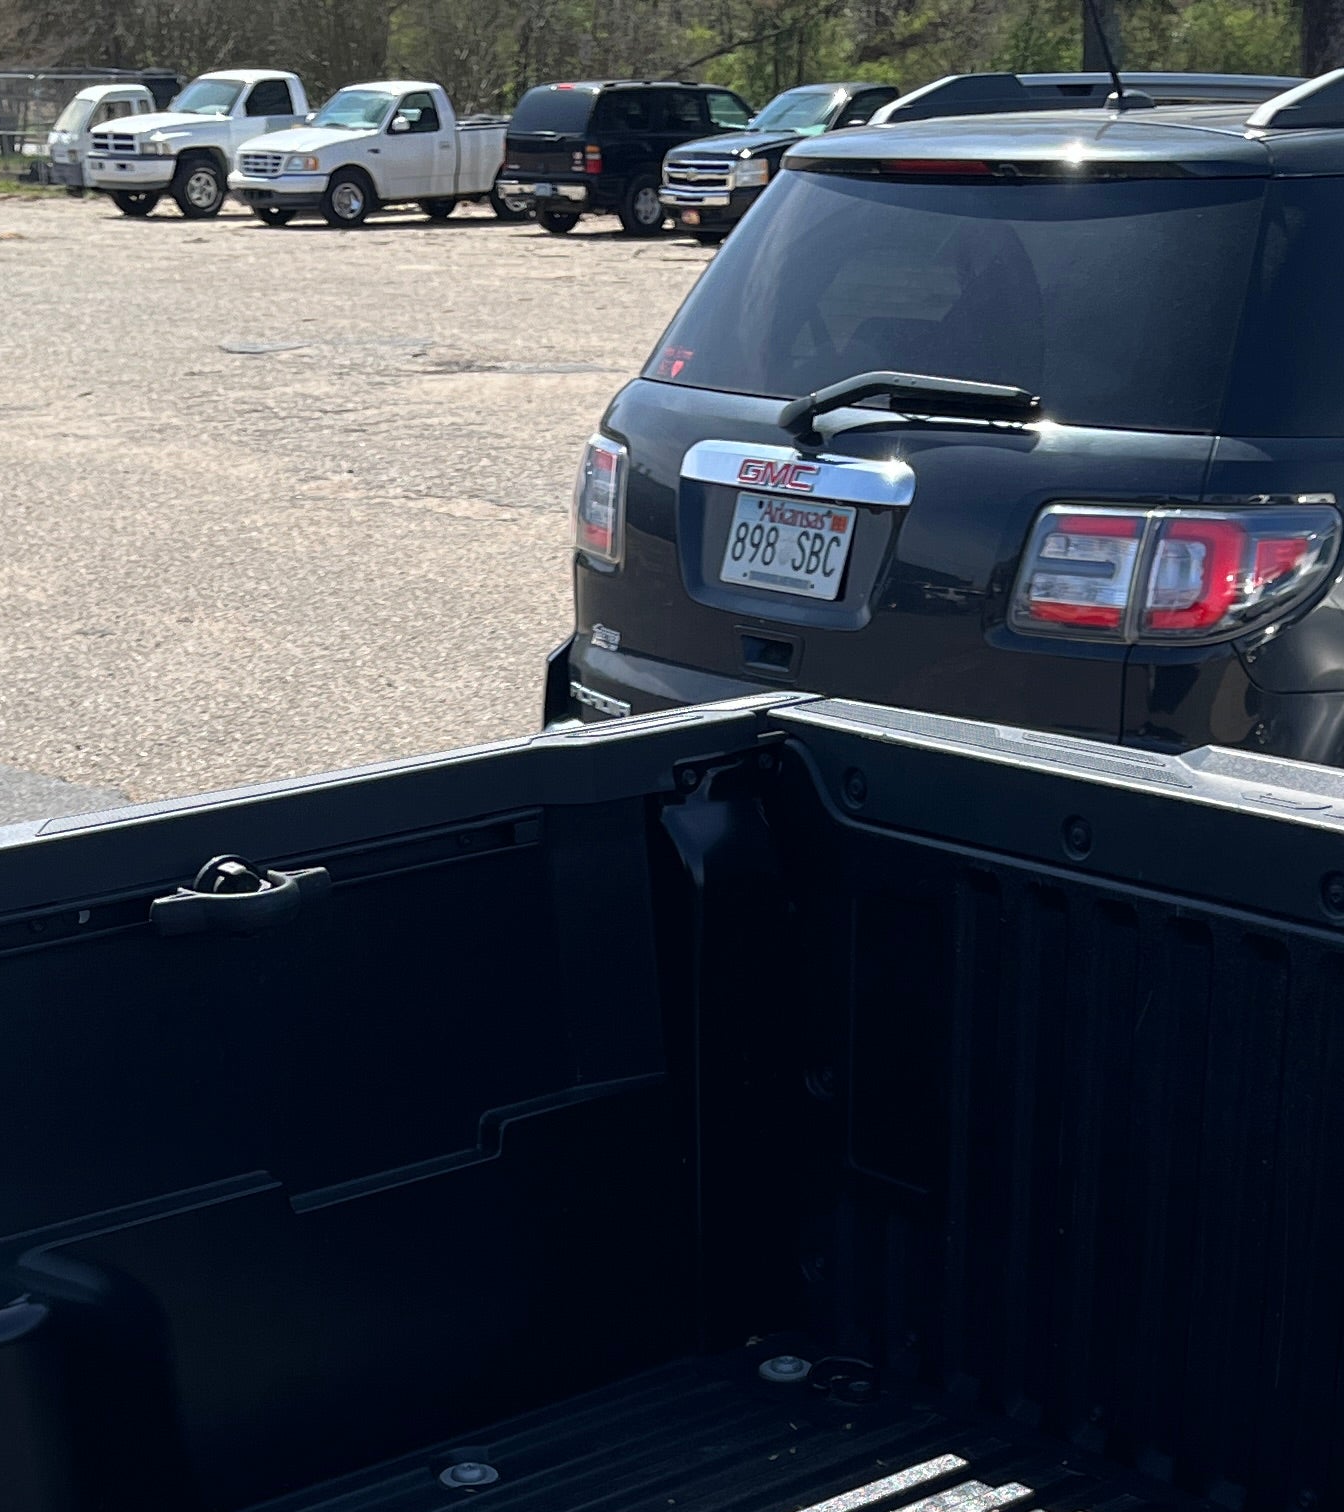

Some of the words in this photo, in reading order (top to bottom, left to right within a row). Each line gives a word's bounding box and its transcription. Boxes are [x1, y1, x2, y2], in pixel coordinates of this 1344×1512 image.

[737, 458, 820, 492] GMC
[760, 500, 826, 531] Arkansas
[731, 522, 780, 566] 898
[791, 530, 842, 577] SBC
